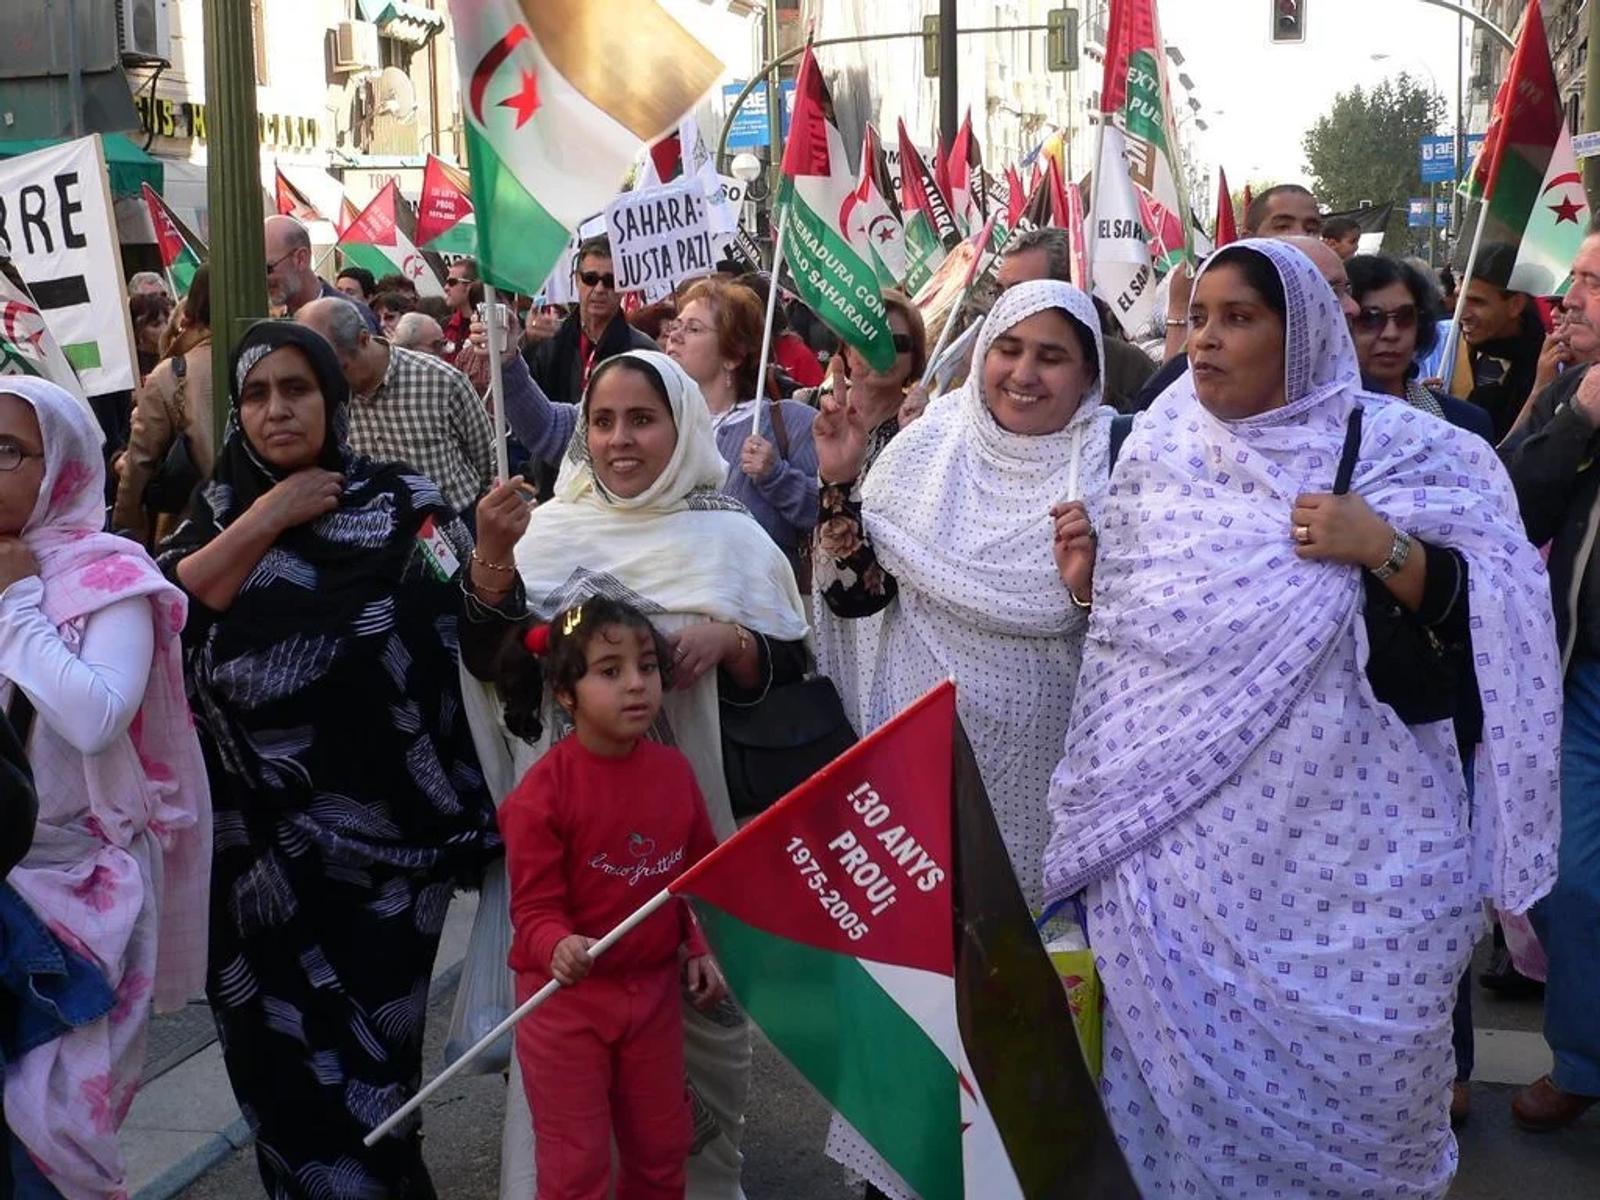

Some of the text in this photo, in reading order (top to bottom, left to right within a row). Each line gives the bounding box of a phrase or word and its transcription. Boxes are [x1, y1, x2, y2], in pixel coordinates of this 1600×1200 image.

[613, 193, 704, 245] SAHARA:
[808, 269, 879, 342] SAHARAUI
[855, 285, 886, 318] CON
[786, 836, 870, 941] 1975-2005
[876, 825, 946, 893] ANYS
